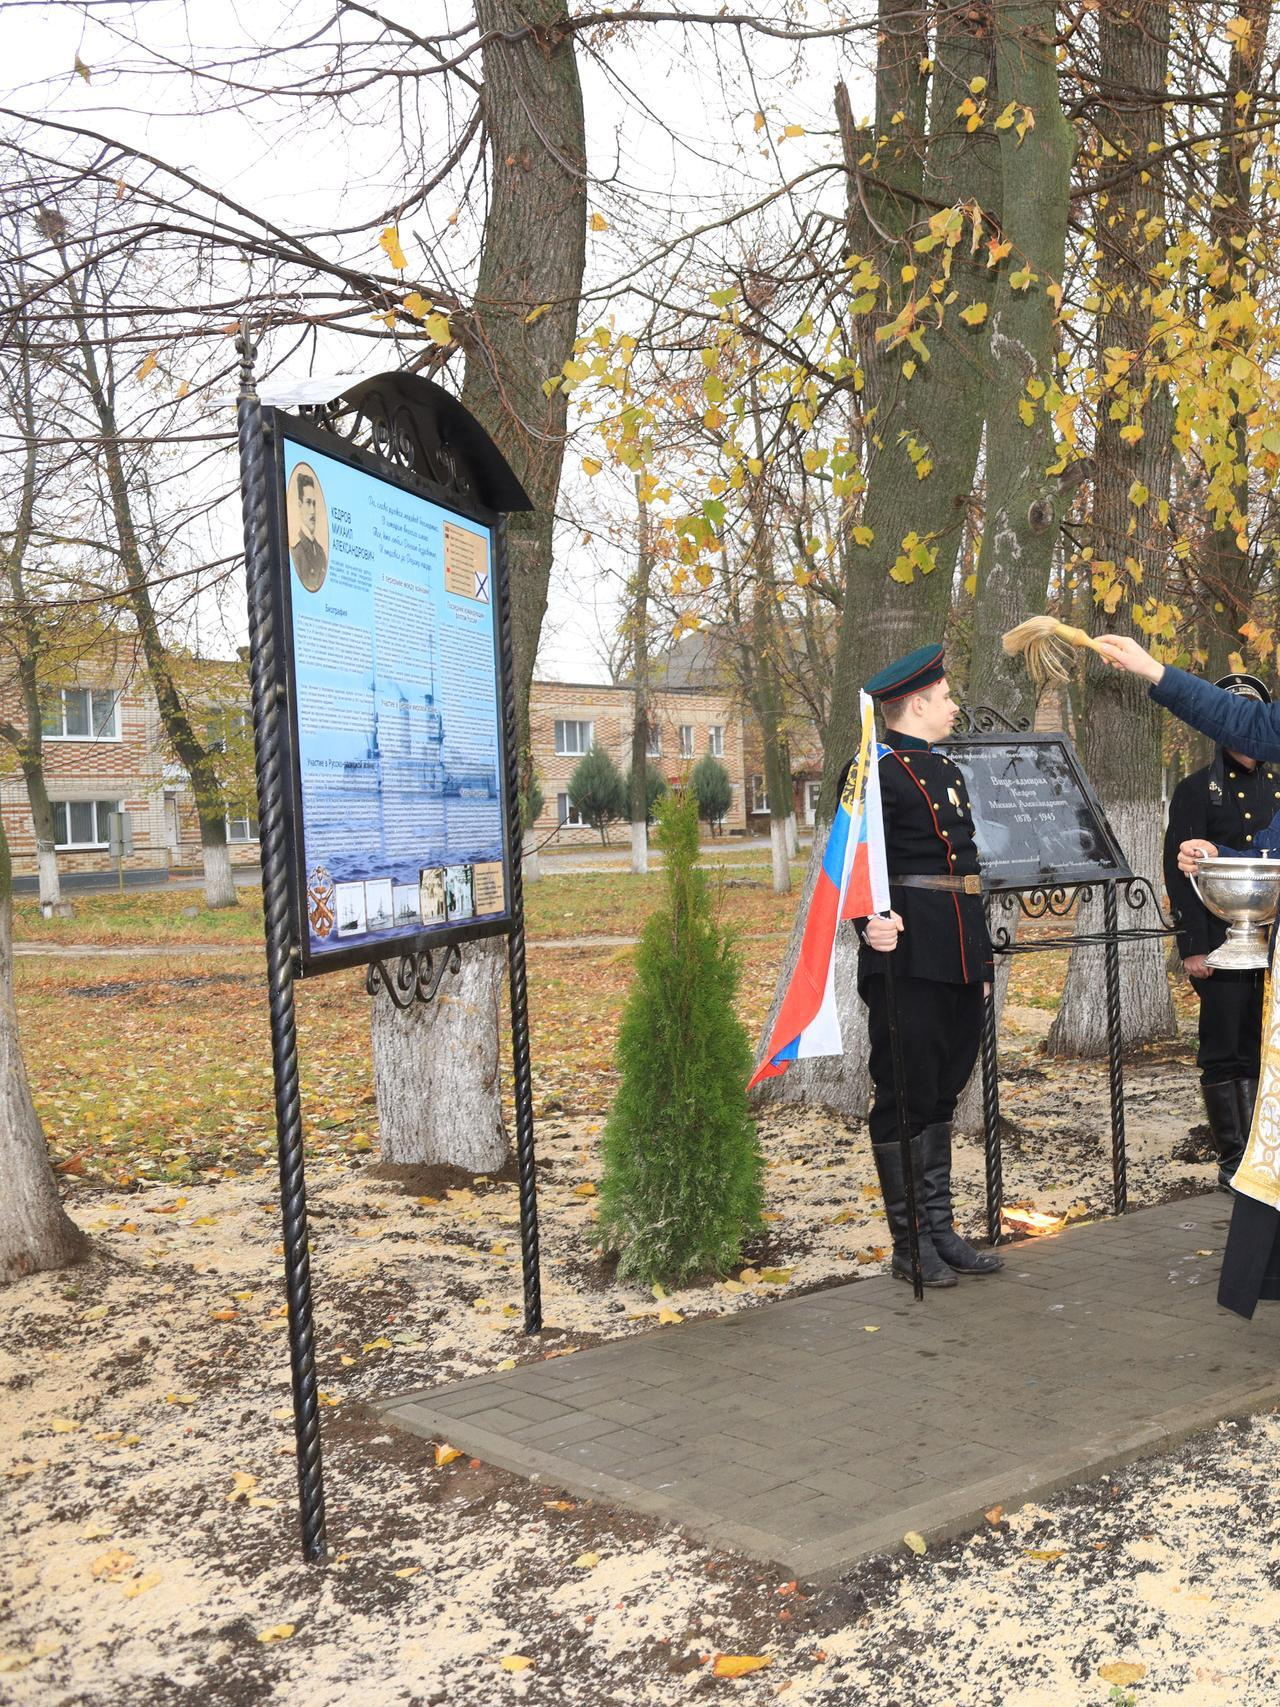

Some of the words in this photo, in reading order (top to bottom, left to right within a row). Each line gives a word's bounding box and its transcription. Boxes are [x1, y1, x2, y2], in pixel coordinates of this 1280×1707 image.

[331, 507, 352, 524] КЕДРОВ
[332, 539, 375, 561] АЛЕКСАНДРОВИЧ
[990, 776, 1048, 788] Вице-адмирал
[1010, 788, 1037, 798] Кедров
[988, 800, 1017, 809] Михаил
[1019, 799, 1069, 809] Александрович
[1014, 813, 1032, 823] 1878
[1038, 812, 1056, 822] 1945
